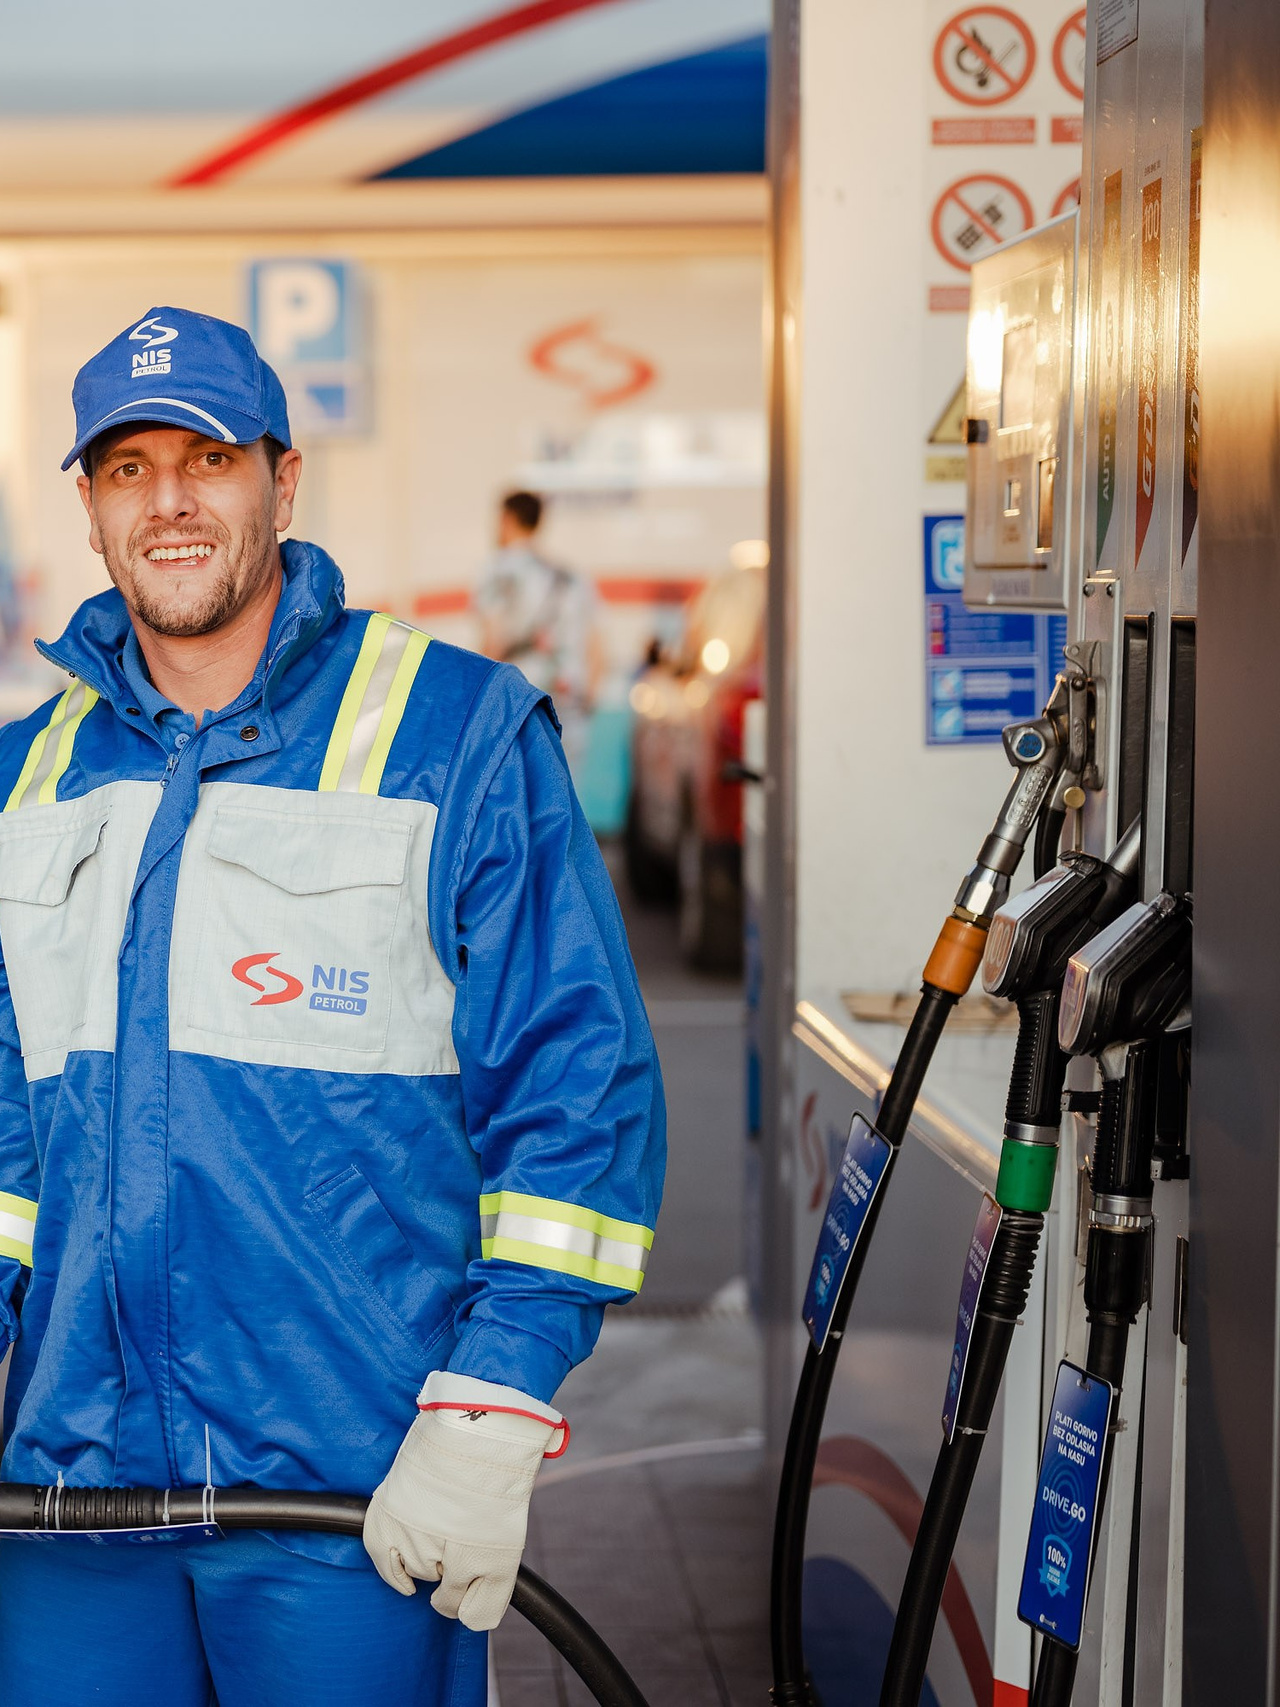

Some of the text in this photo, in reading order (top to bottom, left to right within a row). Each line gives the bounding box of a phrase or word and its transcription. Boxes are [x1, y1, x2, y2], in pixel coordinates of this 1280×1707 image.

[1144, 199, 1160, 243] 100
[258, 266, 338, 356] P
[132, 348, 171, 368] NIS
[135, 365, 168, 375] PETROL
[1102, 433, 1111, 500] AUTO
[312, 964, 370, 994] NIS
[314, 996, 361, 1012] PETROL
[1052, 1425, 1096, 1457] BEZ ODLASKA
[1055, 1411, 1098, 1442] PLATI GORIVO
[1058, 1443, 1086, 1466] NA KASU
[1042, 1486, 1086, 1522] DRIVE.GO
[1047, 1545, 1067, 1569] 100%
